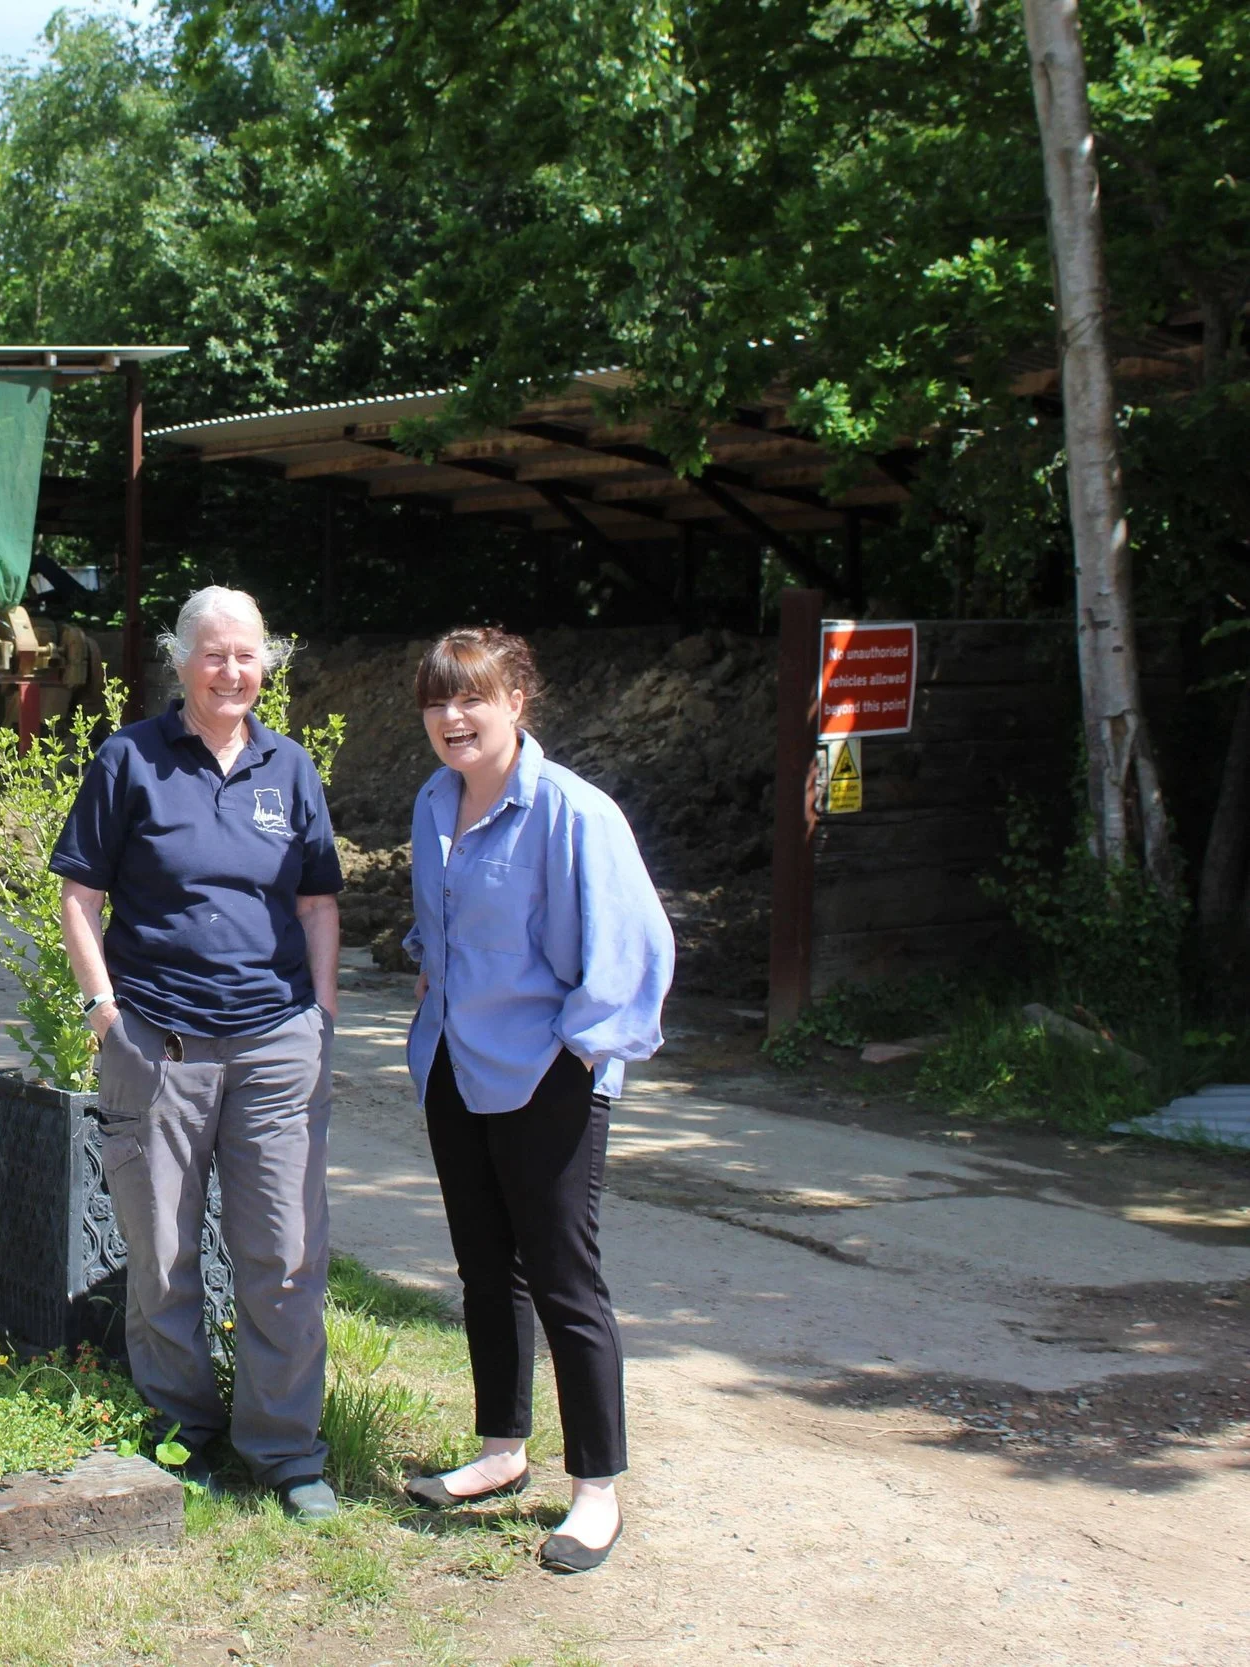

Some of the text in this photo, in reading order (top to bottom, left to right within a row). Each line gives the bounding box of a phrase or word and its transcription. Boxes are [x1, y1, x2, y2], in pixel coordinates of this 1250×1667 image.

[828, 645, 909, 661] No unauthorised
[828, 672, 907, 688] vehicles allowed
[824, 698, 907, 717] beyond this point
